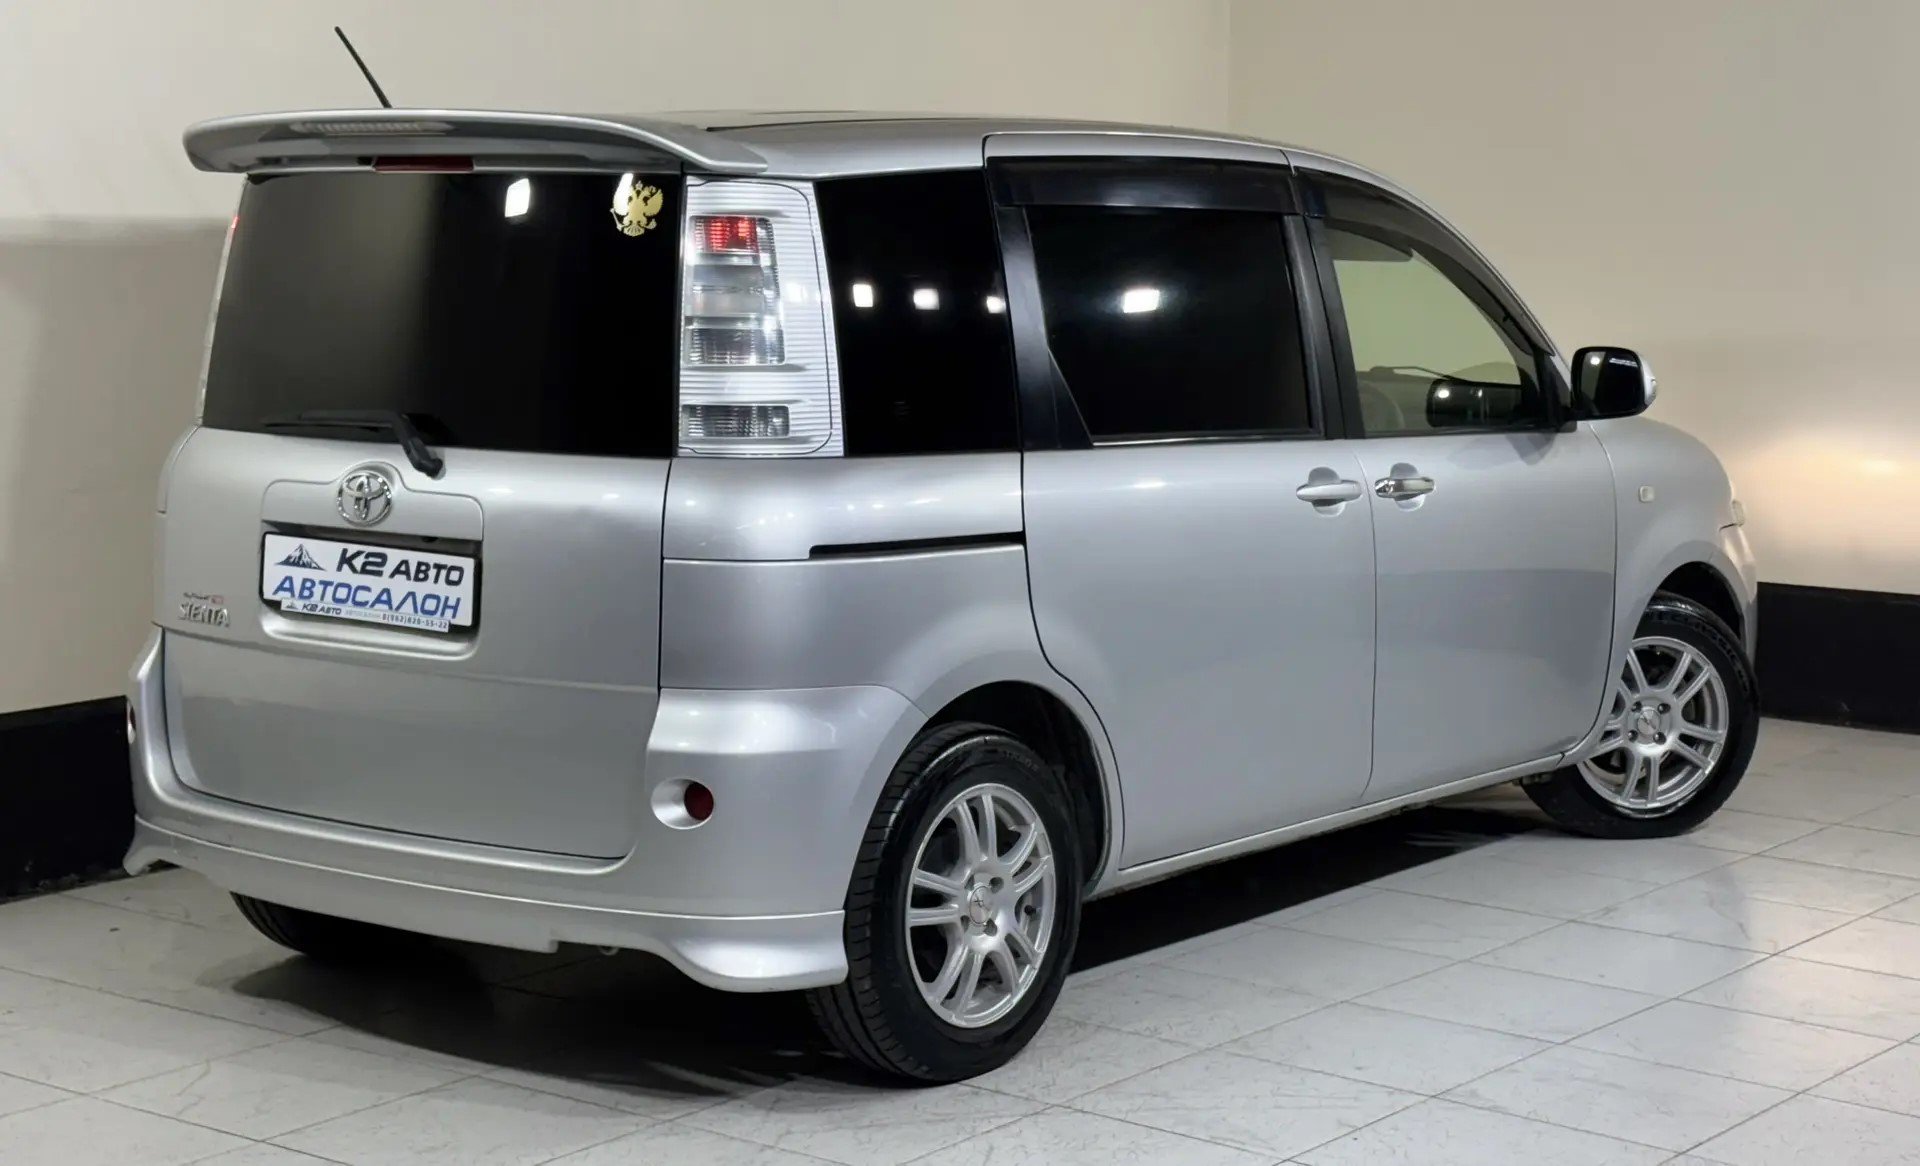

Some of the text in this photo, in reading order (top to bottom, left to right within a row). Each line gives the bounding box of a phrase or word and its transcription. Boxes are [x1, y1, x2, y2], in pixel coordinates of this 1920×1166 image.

[389, 559, 465, 586] АВТО
[272, 575, 462, 620] АВТОСАЛОН
[318, 605, 342, 615] АВТО
